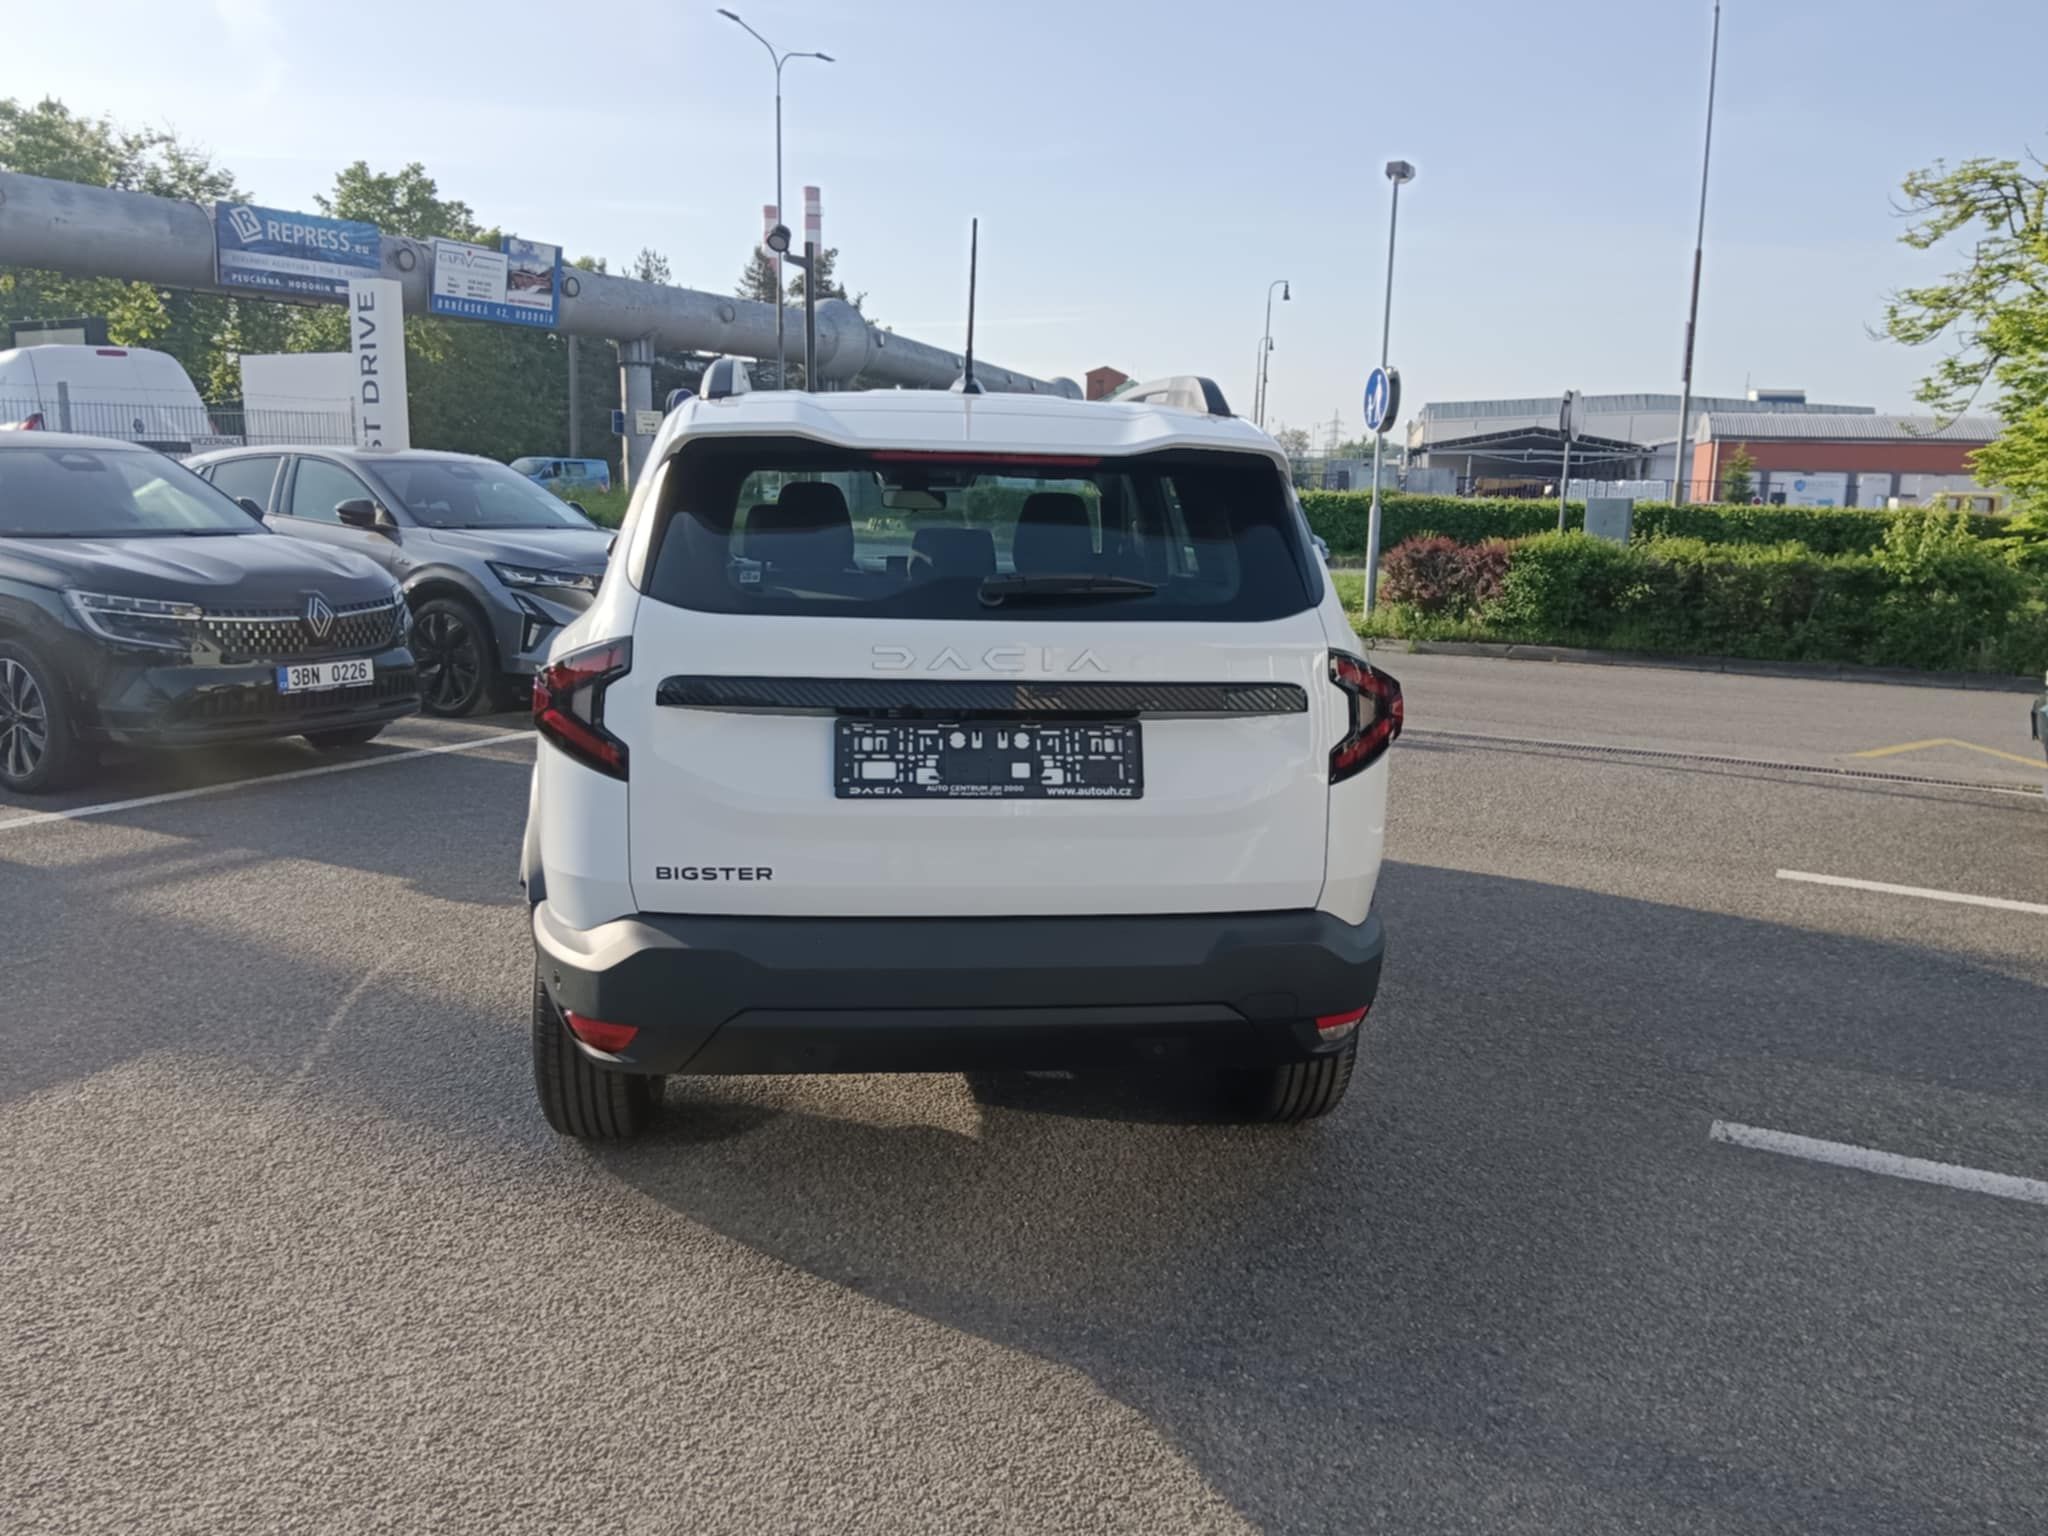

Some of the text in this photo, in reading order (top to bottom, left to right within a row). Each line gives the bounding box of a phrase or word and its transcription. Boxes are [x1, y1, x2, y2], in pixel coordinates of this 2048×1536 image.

[357, 291, 380, 404] DRIVE
[872, 645, 1110, 672] DACIA
[291, 662, 367, 686] 3BN 0226
[849, 786, 903, 795] DACIA
[1046, 785, 1132, 796] www.autouh.cz
[656, 866, 773, 880] BIGSTER
